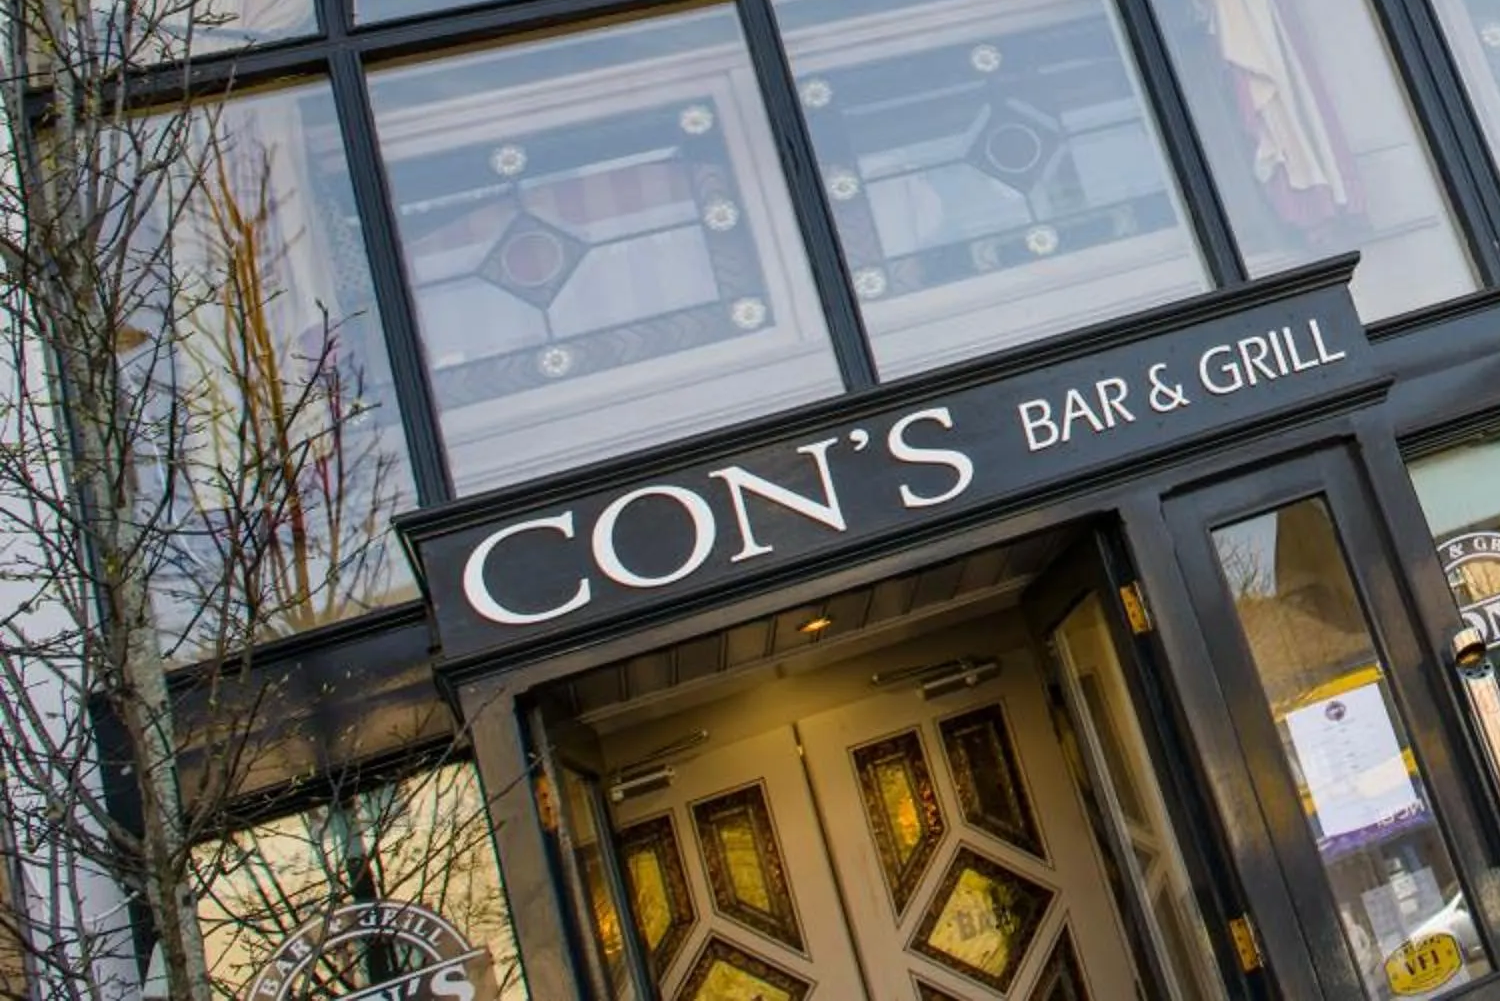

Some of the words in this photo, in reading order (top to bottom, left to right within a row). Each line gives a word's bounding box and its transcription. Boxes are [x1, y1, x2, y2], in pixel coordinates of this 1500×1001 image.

[462, 407, 975, 626] CON'S
[1018, 376, 1137, 453] BAR
[1147, 361, 1192, 414] &
[1198, 317, 1346, 397] GRILL
